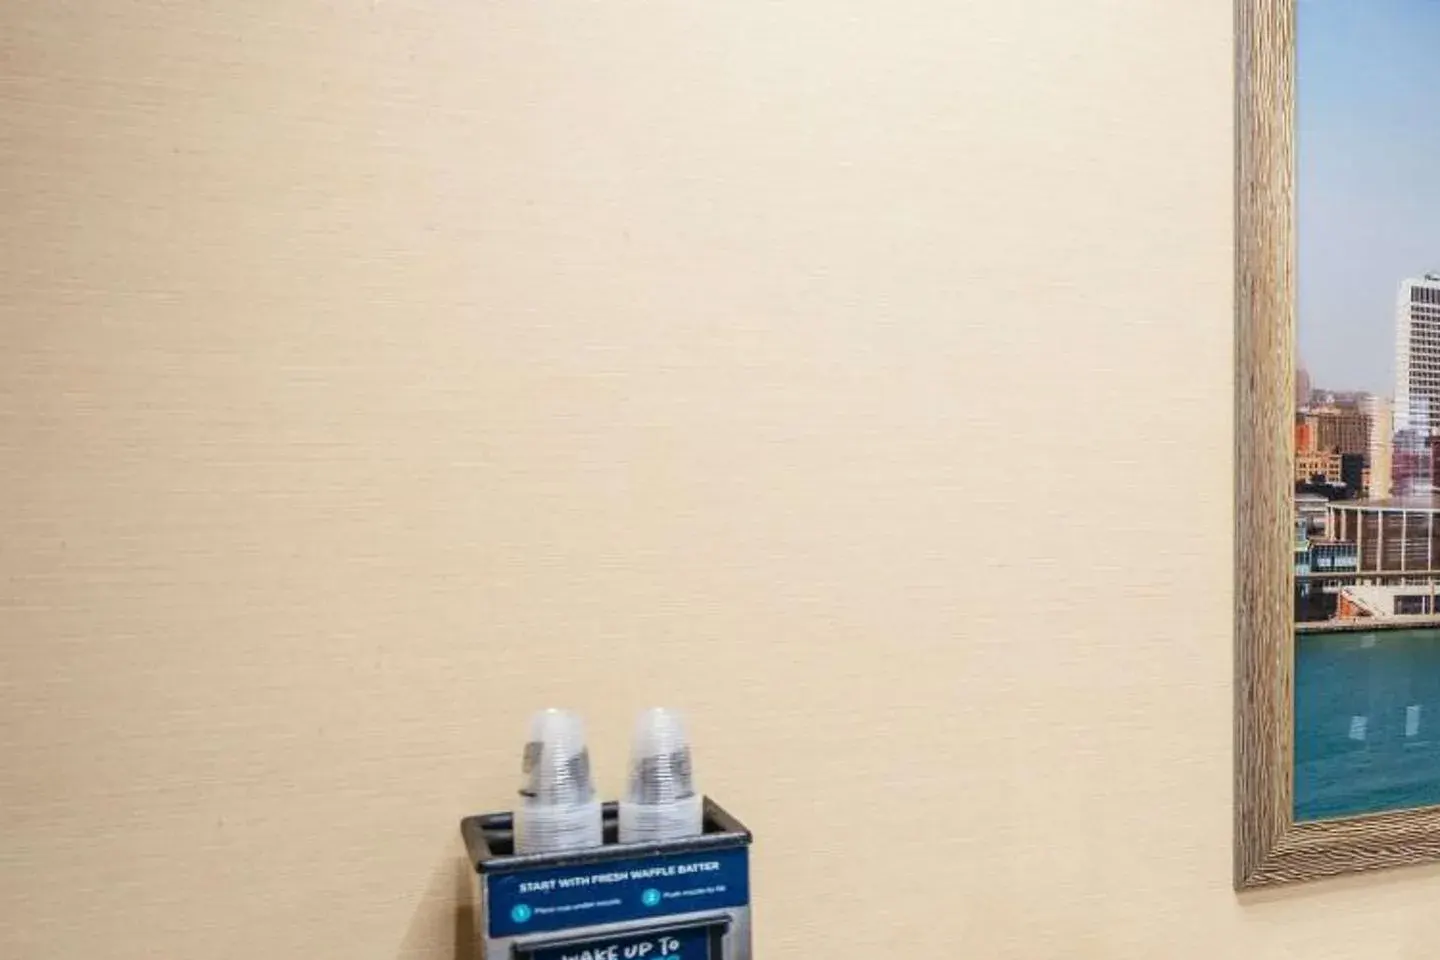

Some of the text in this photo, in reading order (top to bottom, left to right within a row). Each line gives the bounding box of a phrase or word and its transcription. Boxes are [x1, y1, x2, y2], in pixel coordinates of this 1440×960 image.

[518, 861, 720, 893] START WITH FRESH WAFFLE BATTER
[624, 941, 653, 959] UP
